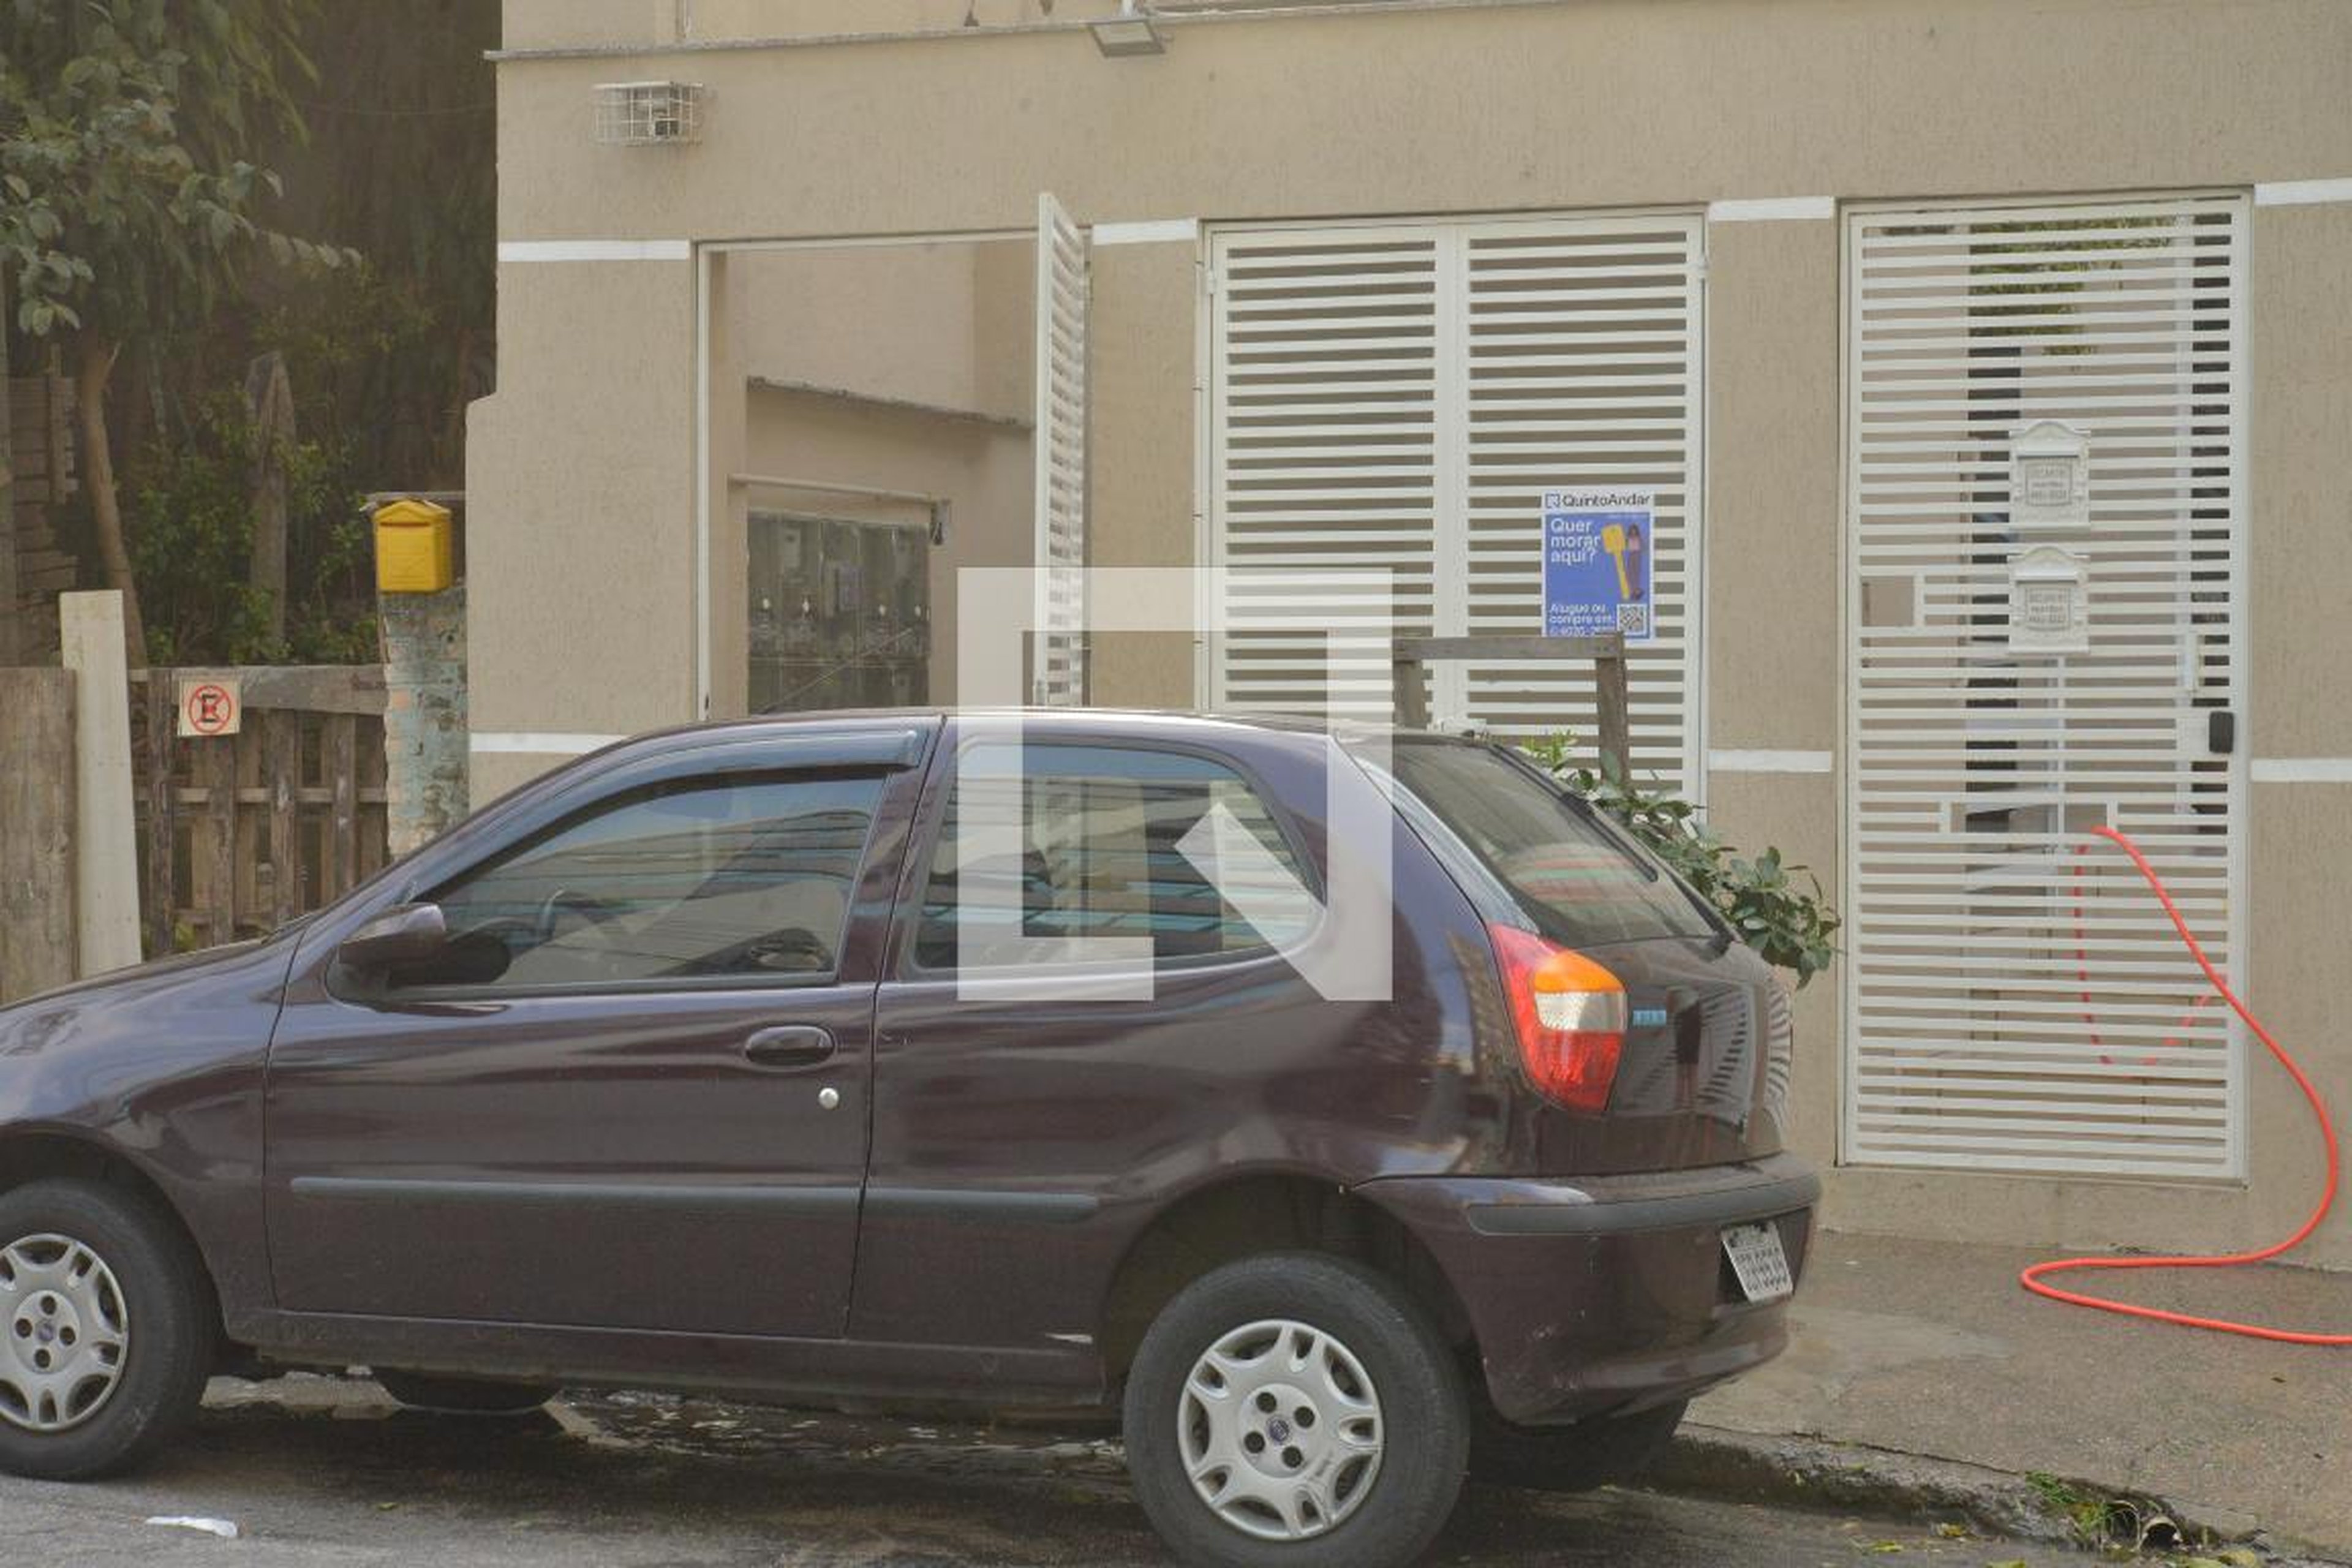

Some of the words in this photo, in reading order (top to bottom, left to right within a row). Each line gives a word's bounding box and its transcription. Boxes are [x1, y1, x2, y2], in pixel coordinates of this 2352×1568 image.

[1562, 494, 1650, 507] QuintoAndar
[1551, 518, 1592, 533] Quer
[1551, 535, 1600, 548] morar
[1551, 548, 1597, 565] aqui?
[202, 693, 219, 723] E
